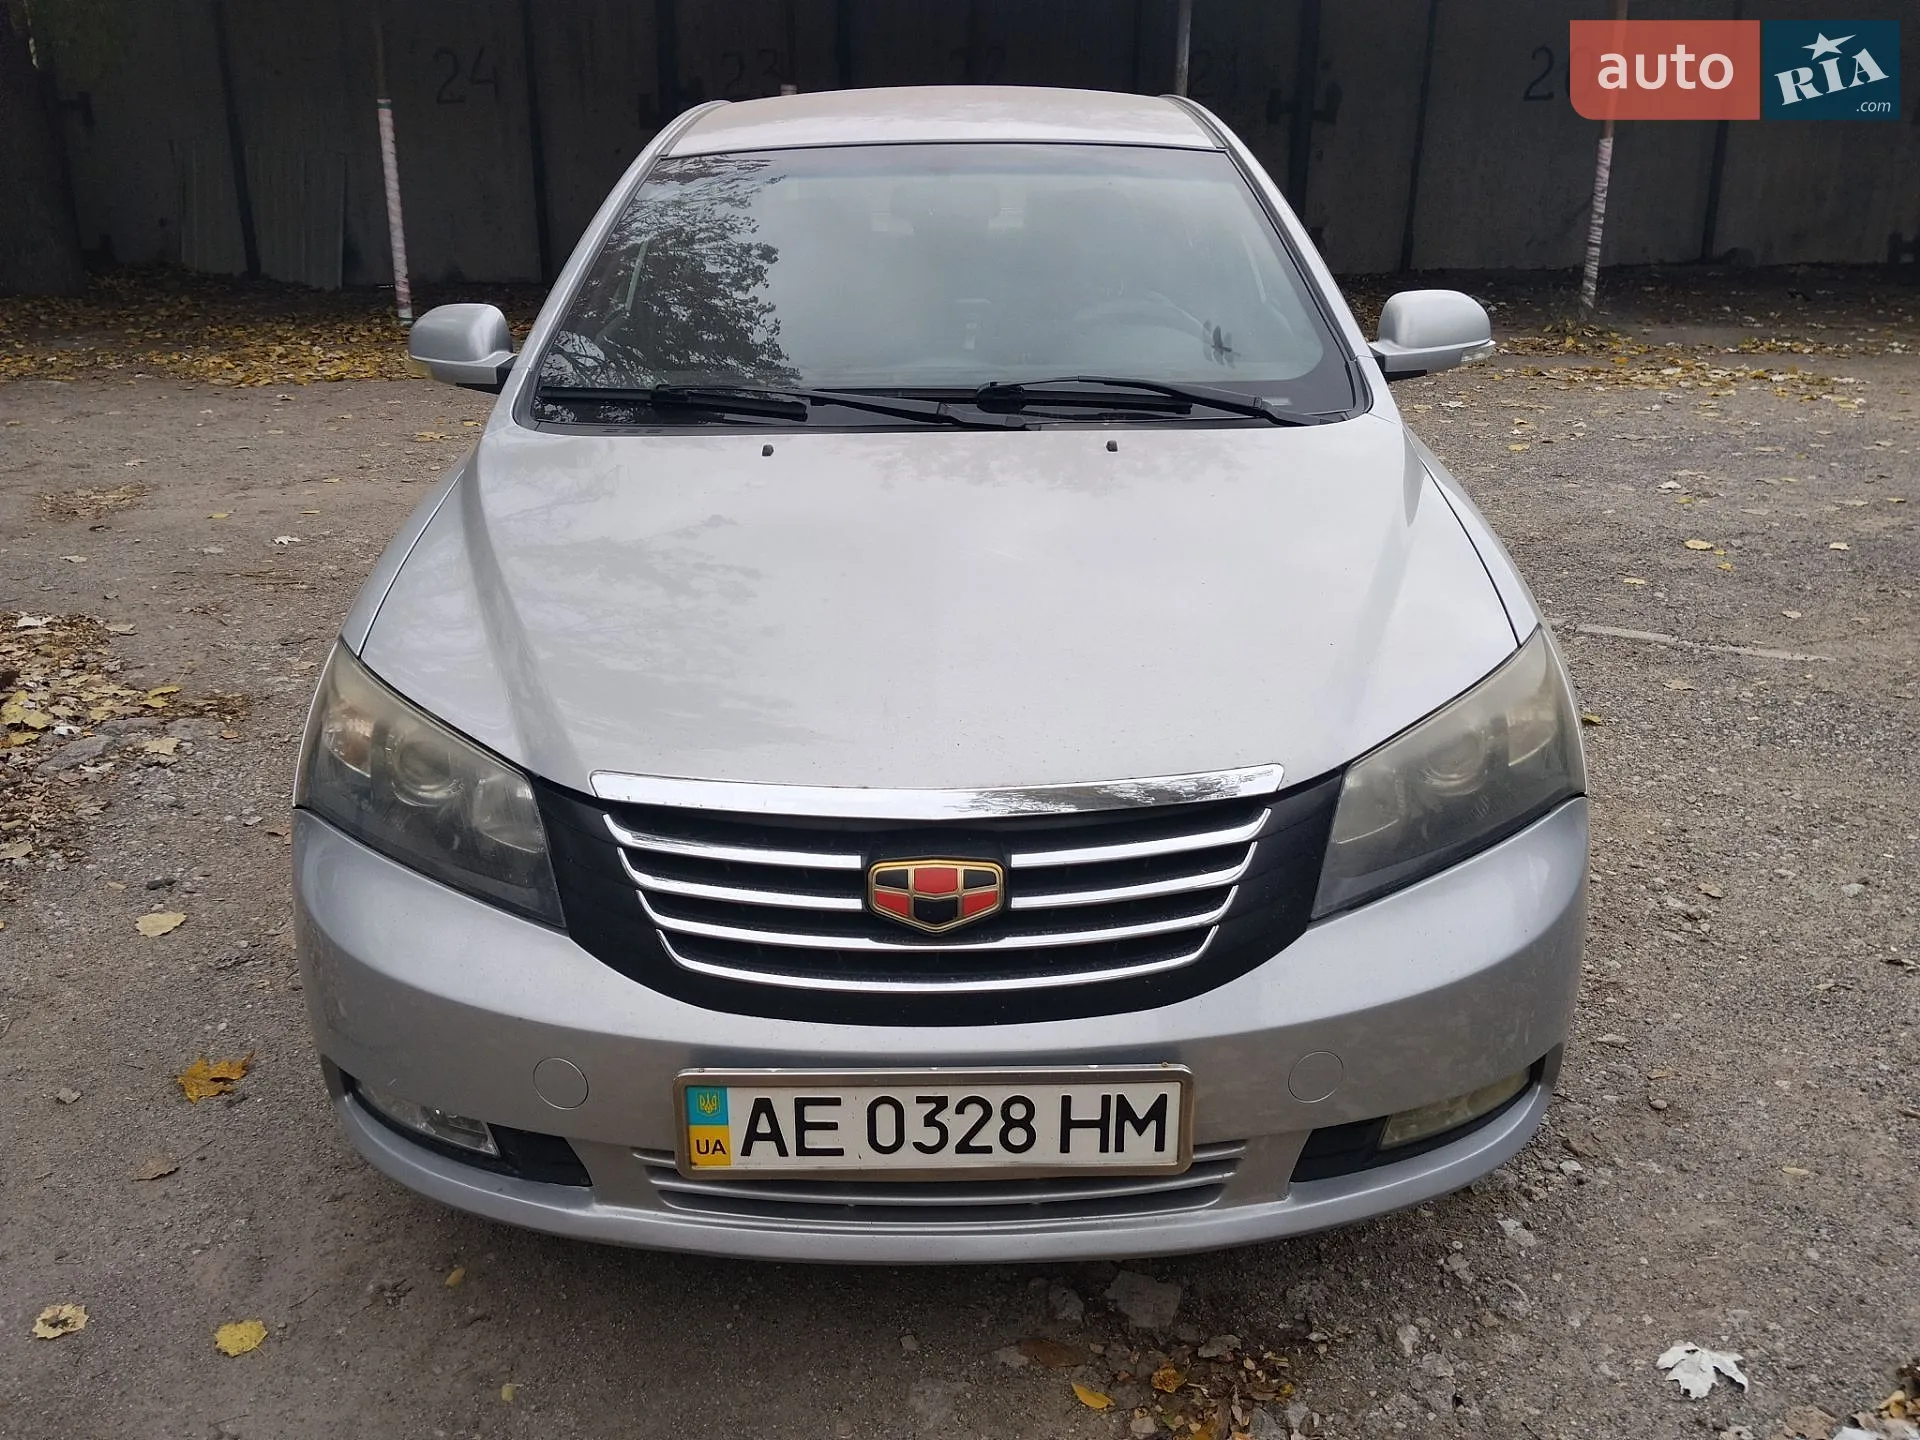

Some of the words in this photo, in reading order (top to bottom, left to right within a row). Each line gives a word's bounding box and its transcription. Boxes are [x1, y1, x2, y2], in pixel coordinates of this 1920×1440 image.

[432, 46, 501, 105] 24
[695, 1138, 727, 1155] UA
[740, 1096, 844, 1157] AE
[866, 1094, 1037, 1155] 0328
[1059, 1093, 1168, 1154] HM
